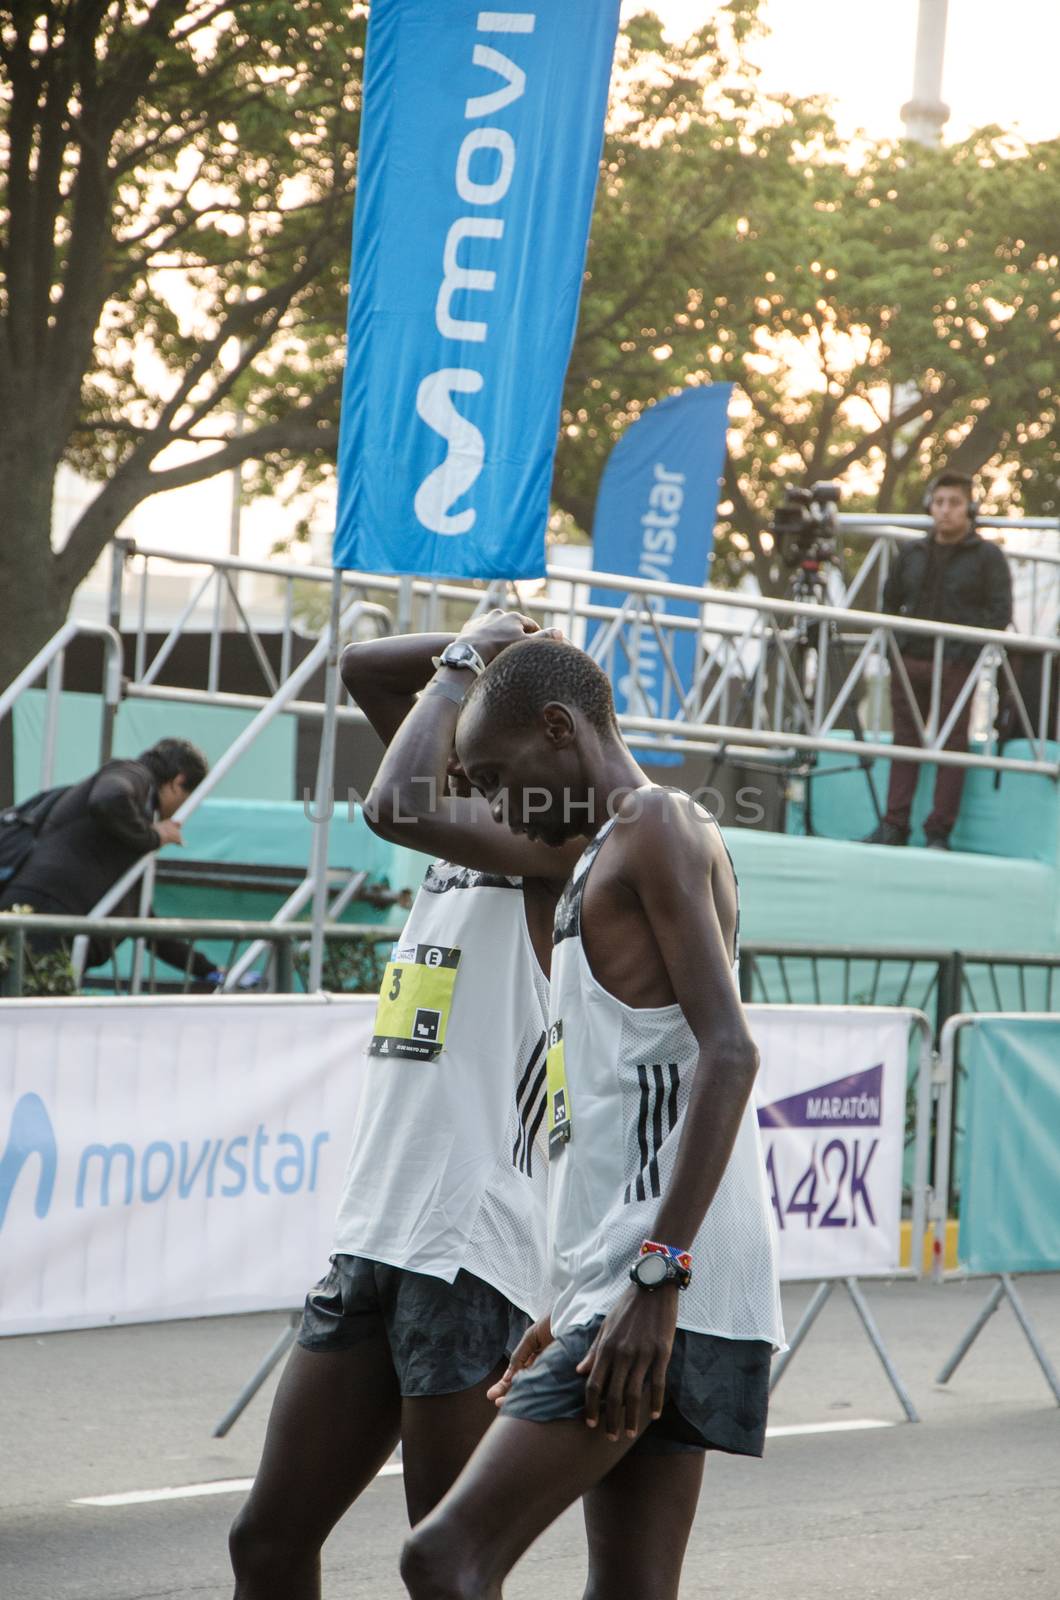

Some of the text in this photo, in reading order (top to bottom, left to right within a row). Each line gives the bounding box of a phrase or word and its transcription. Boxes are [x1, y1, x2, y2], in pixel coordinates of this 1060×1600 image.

[428, 952, 439, 966] E
[389, 968, 403, 1001] 3
[805, 1093, 880, 1119] MARATÓN
[75, 1123, 330, 1208] movistar
